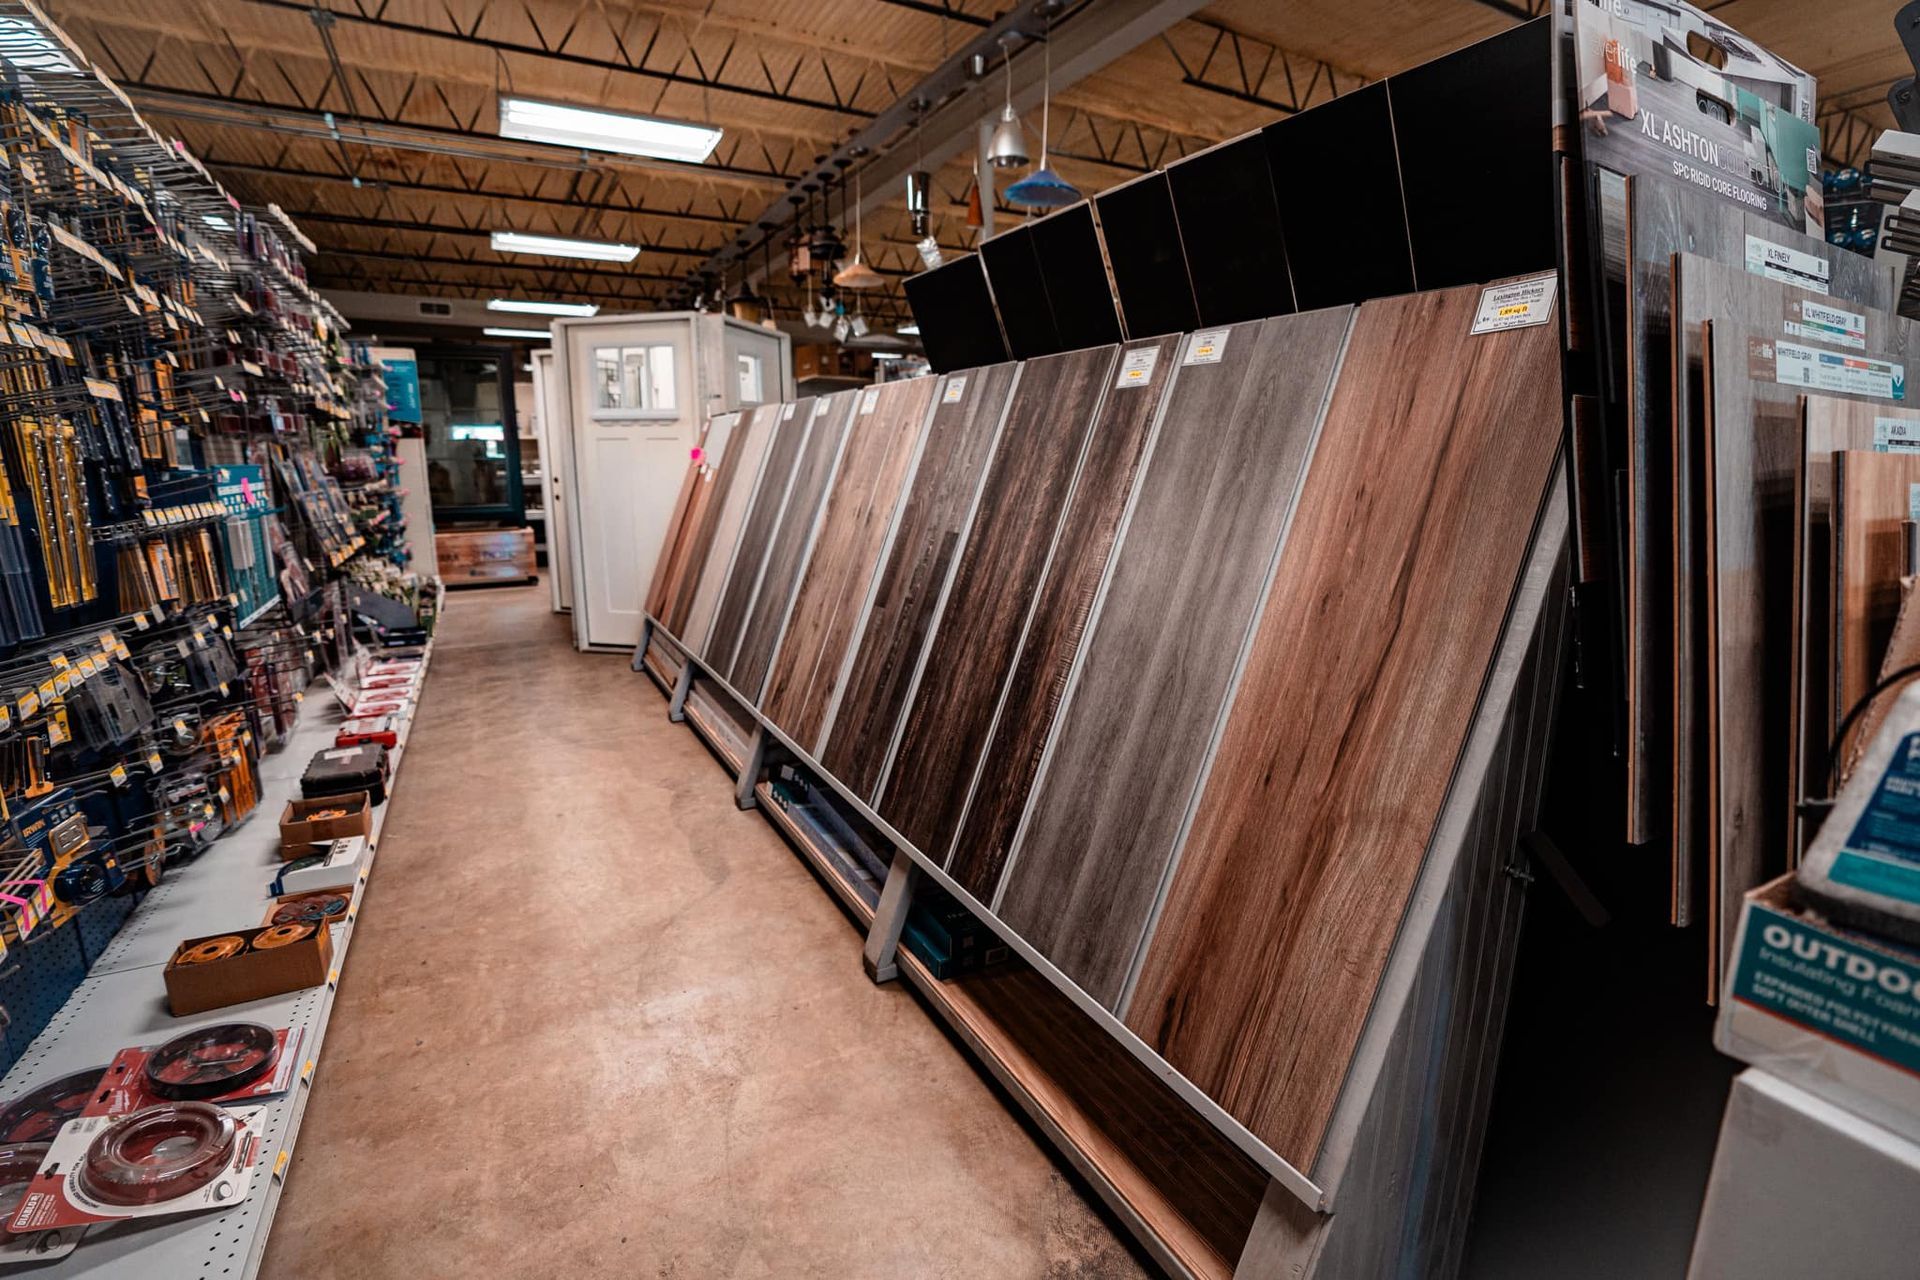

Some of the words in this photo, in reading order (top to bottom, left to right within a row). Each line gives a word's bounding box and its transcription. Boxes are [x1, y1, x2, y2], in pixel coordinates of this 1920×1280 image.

[1640, 108, 1660, 141] XL
[1662, 120, 1719, 167] ASHTON
[1673, 160, 1690, 180] SPC
[1690, 167, 1711, 189] RIGID
[1711, 177, 1732, 197] CORE
[1732, 185, 1767, 211] FLOORING
[1493, 292, 1520, 301] Lexington
[1521, 287, 1544, 296] Hickory
[22, 818, 46, 838] IRWIN
[1759, 946, 1856, 998] Insulating
[1762, 924, 1920, 1000] OUTDO
[1752, 982, 1786, 1004] SOFT
[1786, 997, 1832, 1023] OUTER
[1833, 1016, 1876, 1043] SHELL
[1754, 970, 1825, 1007] EXPANDED
[16, 1200, 38, 1226] DIABLO
